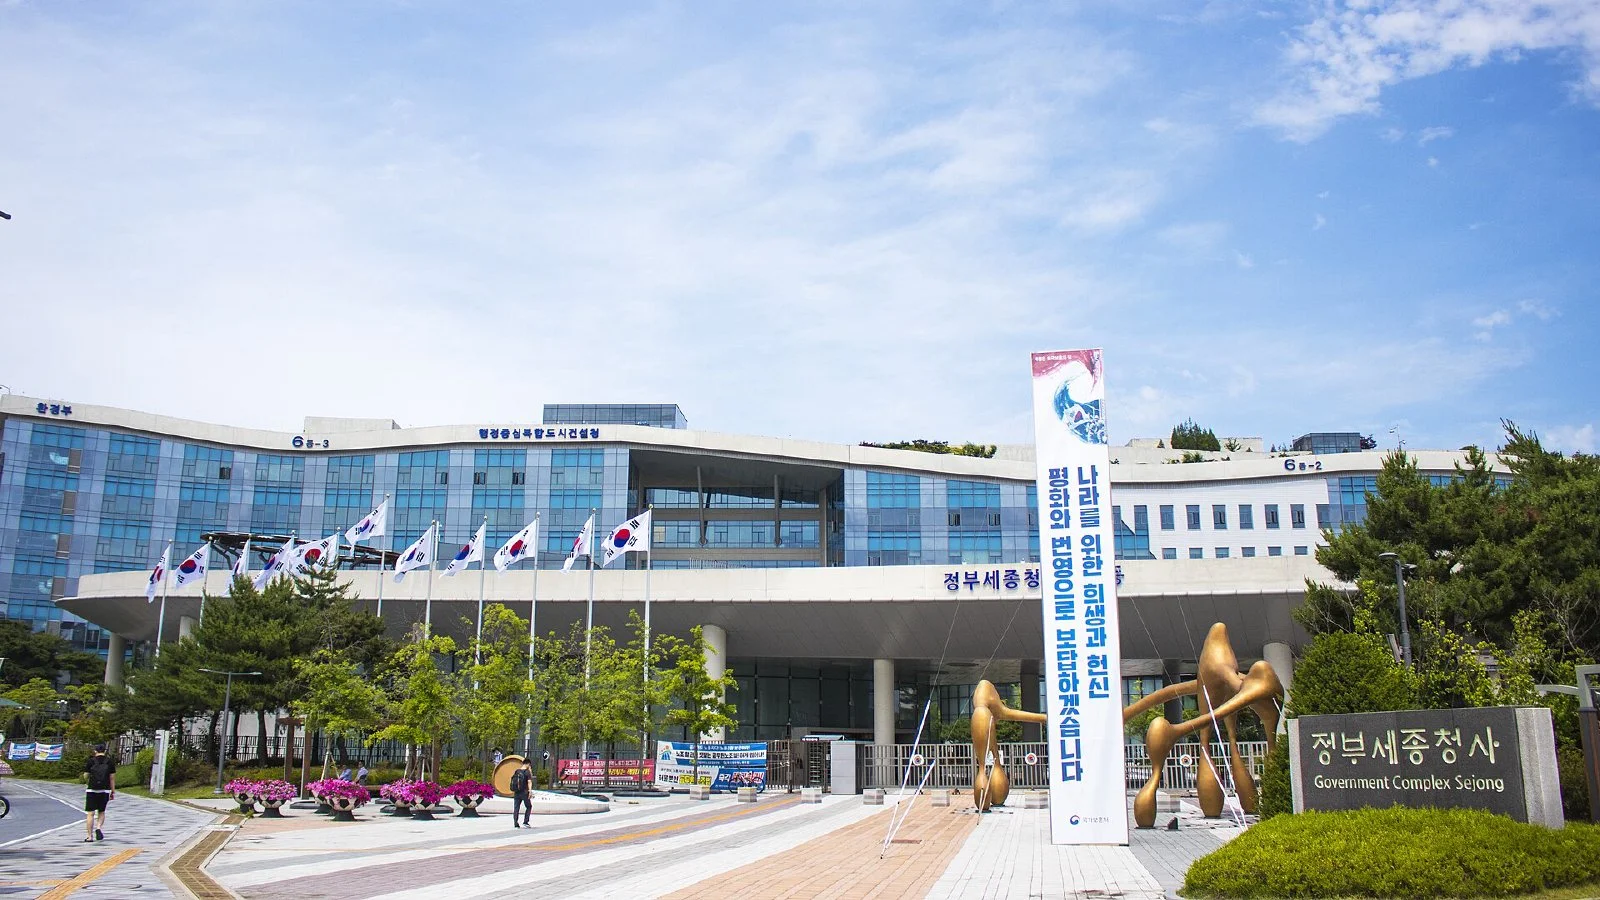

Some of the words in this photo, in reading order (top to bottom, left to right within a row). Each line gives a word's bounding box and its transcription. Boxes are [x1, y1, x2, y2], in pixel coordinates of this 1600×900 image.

[36, 403, 72, 416] 환경부
[479, 428, 599, 439] 행정중심복합도시건설청
[1049, 467, 1071, 529] 평화와
[1078, 465, 1100, 528] 나라를
[1051, 536, 1076, 620] 번영으로
[1081, 534, 1103, 577] 위한
[1083, 583, 1107, 647] 희생과
[1087, 654, 1109, 699] 헌신
[1056, 628, 1083, 782] 보답하겠습니다
[1311, 726, 1500, 766] 정부세종청사
[1314, 774, 1390, 789] Government
[1393, 774, 1451, 792] Complex
[1455, 774, 1504, 793] Sejong
